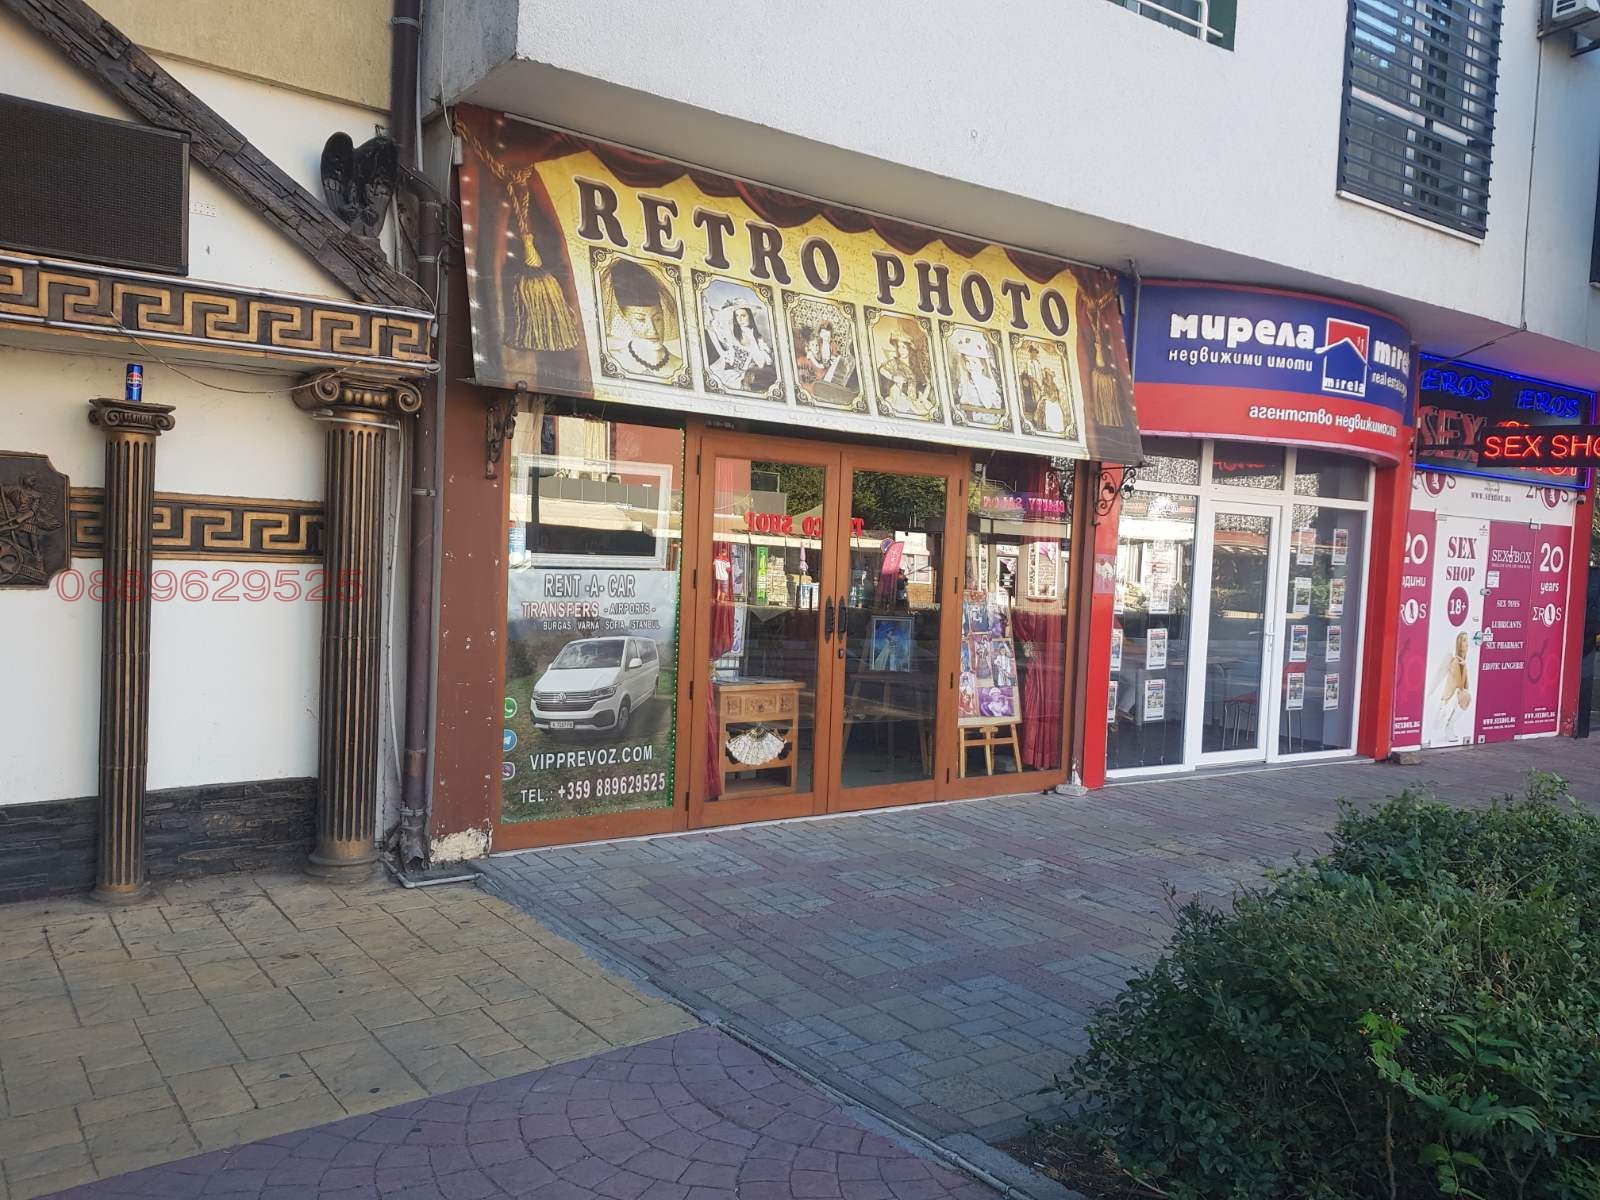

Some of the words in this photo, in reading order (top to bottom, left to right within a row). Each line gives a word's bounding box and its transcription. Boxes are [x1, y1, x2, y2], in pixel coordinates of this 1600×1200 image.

[573, 176, 841, 293] RETRO
[871, 250, 1070, 337] PHOTO
[1170, 313, 1315, 350] мирела
[1168, 347, 1262, 367] недвижими
[1267, 356, 1313, 372] имоти
[1324, 377, 1365, 394] mirela
[1421, 368, 1492, 401] EROS
[1517, 389, 1579, 418] EROS
[1249, 404, 1333, 426] агентство
[1484, 434, 1543, 458] SEX
[1447, 536, 1477, 560] SEX
[1539, 543, 1564, 573] 20
[544, 574, 581, 597] RENT
[608, 575, 636, 597] CAR
[1446, 566, 1475, 582] SHOP
[1540, 582, 1559, 594] years
[521, 602, 599, 618] TRANSFERS
[1449, 598, 1467, 615] 18+
[530, 745, 654, 770] VIPPREVOZ.COM
[558, 781, 590, 801] +359
[596, 772, 666, 797] 889629525
